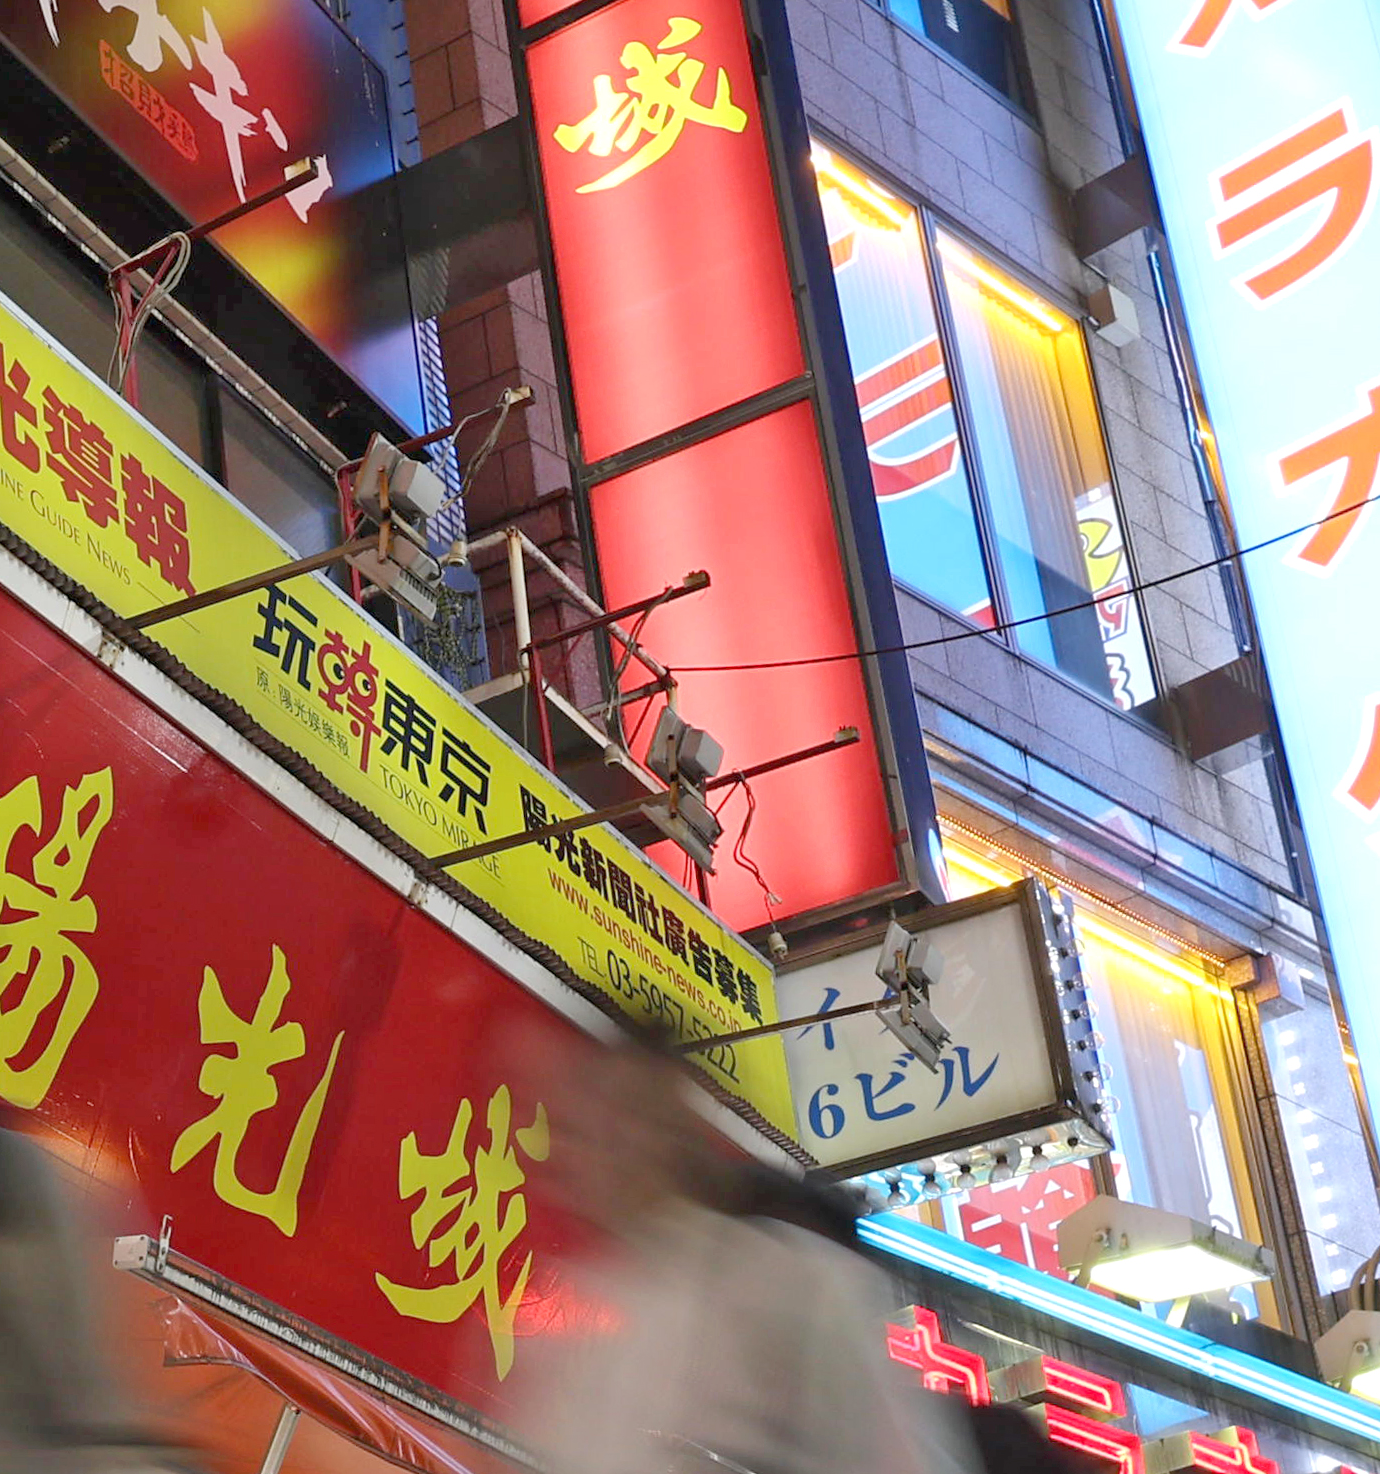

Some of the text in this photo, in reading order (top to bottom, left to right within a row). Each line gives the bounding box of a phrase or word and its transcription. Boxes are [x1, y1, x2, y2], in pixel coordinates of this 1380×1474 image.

[553, 16, 749, 194] 城
[29, 489, 81, 546] GUIDE
[87, 537, 132, 587] NEWS
[379, 764, 437, 827] TOKYO
[808, 1045, 1000, 1140] 6ビル
